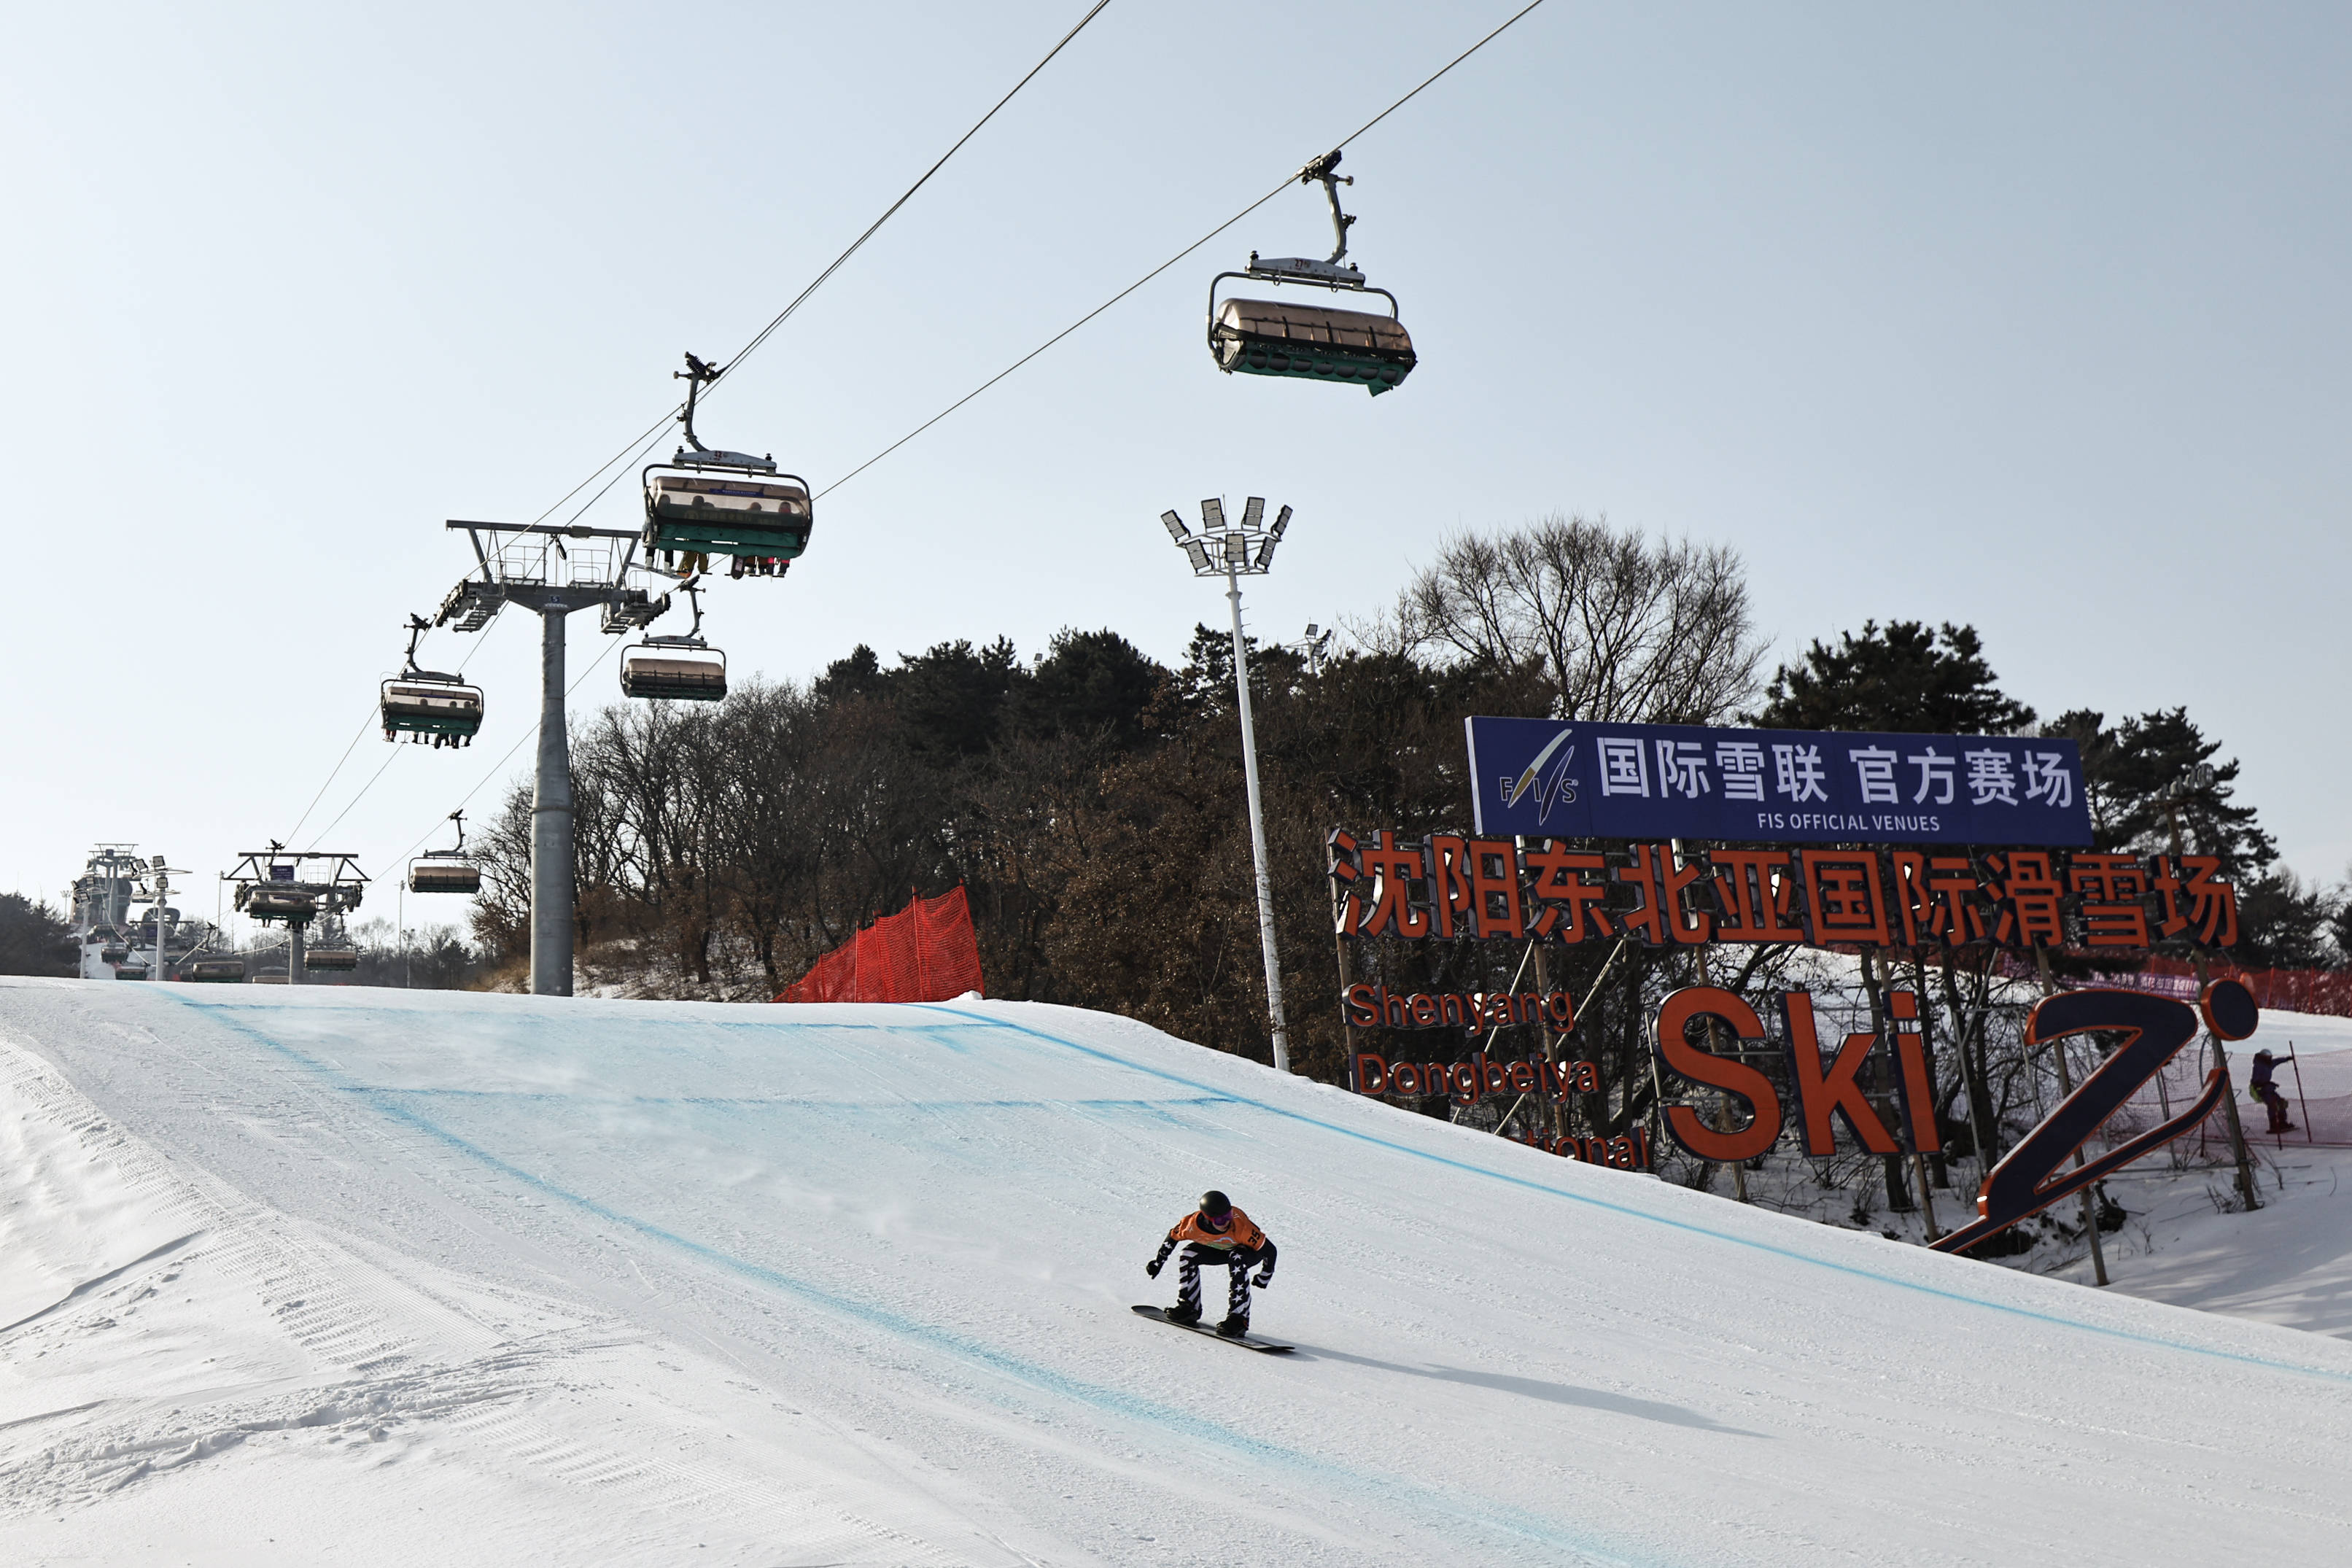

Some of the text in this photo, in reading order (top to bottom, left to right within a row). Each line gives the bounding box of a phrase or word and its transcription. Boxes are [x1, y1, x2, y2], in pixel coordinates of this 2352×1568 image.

[1596, 737, 2074, 808] 国际雪联 官方赛场
[1758, 812, 1941, 832] FIS OFFICIAL VENUES
[1327, 828, 2237, 947] 沈阳东北亚国际滑雪场
[1343, 982, 1575, 1036] Shenyang
[1352, 1052, 1600, 1106] Dongbeiya
[1653, 985, 1941, 1162] Ski
